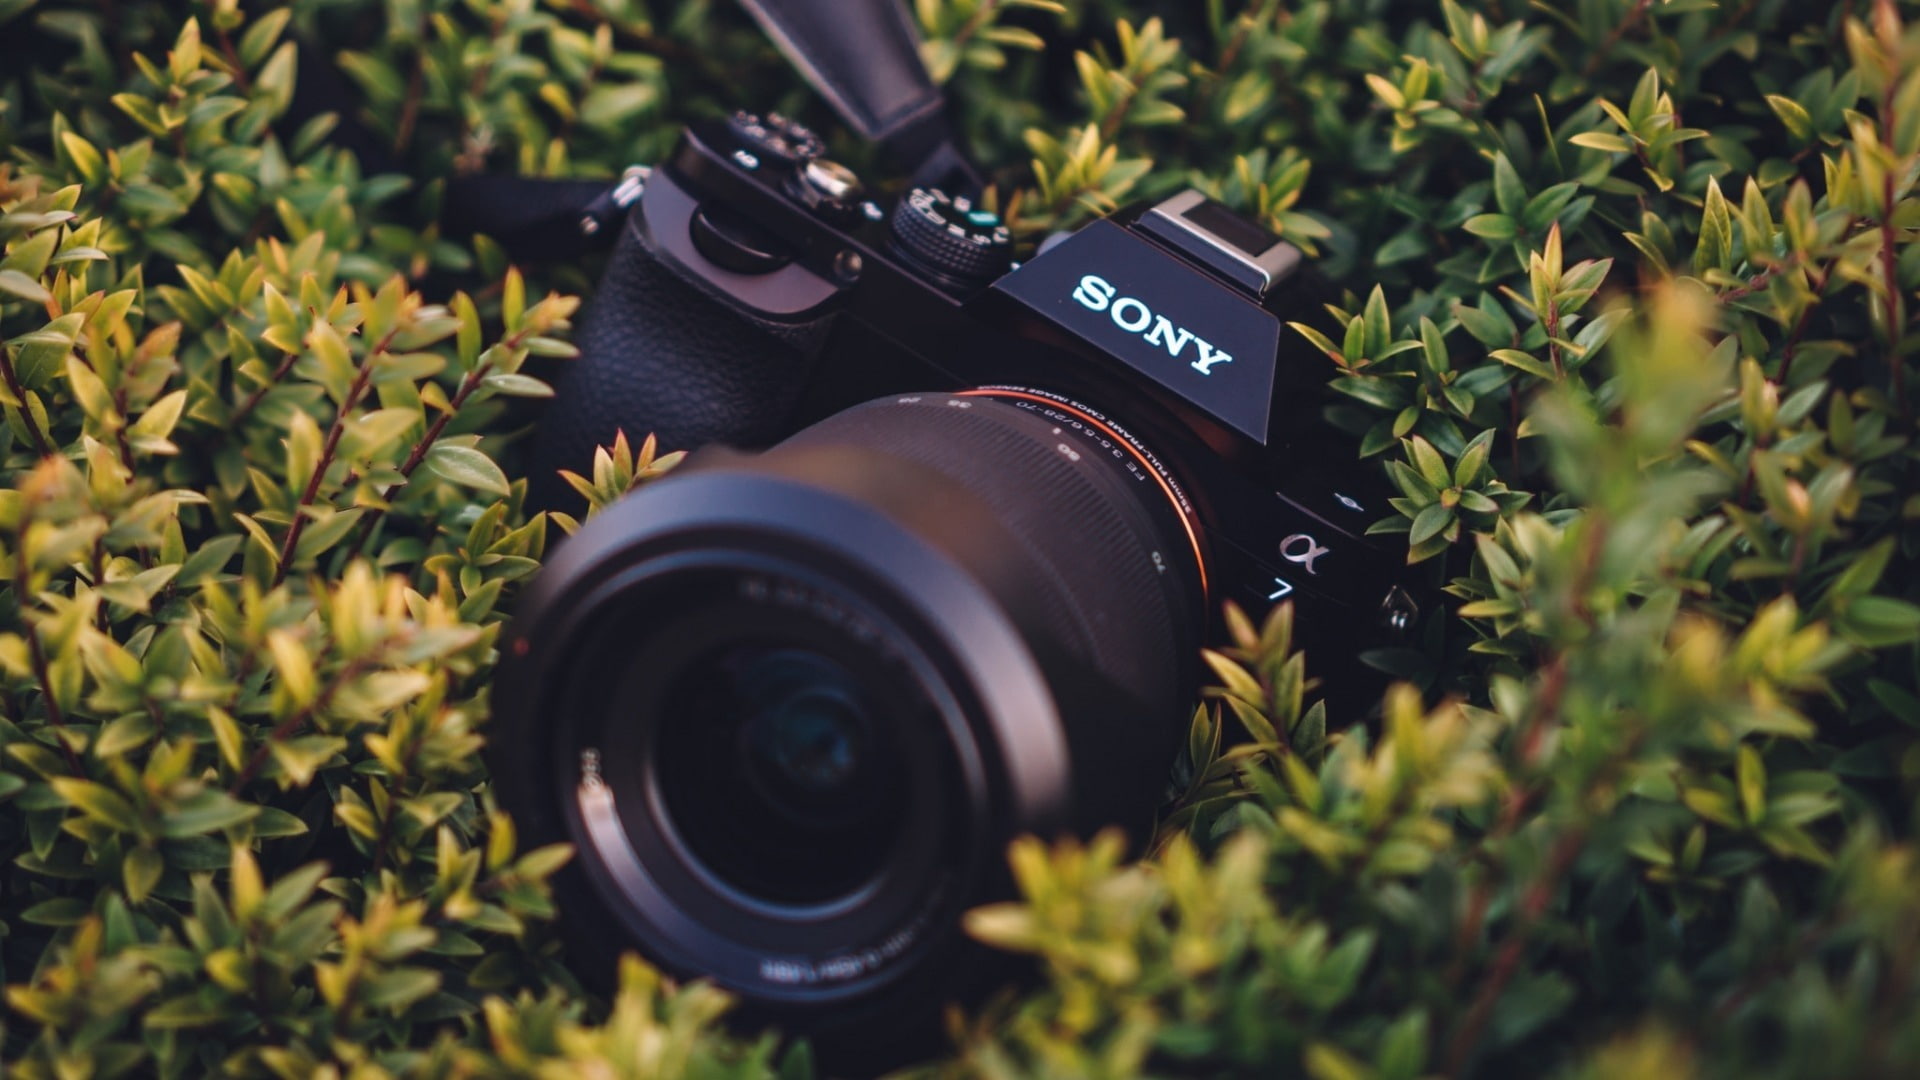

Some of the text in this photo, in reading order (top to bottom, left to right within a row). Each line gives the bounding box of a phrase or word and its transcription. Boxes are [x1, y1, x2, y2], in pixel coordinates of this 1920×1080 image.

[1072, 275, 1233, 376] SONY
[1026, 387, 1070, 403] IMAGE
[1070, 400, 1107, 422] CMOS
[1106, 419, 1169, 477] FULL-FRAME
[1125, 460, 1146, 482] FE
[1168, 477, 1192, 514] 35mm
[1151, 550, 1167, 575] 70
[1268, 577, 1293, 600] 7
